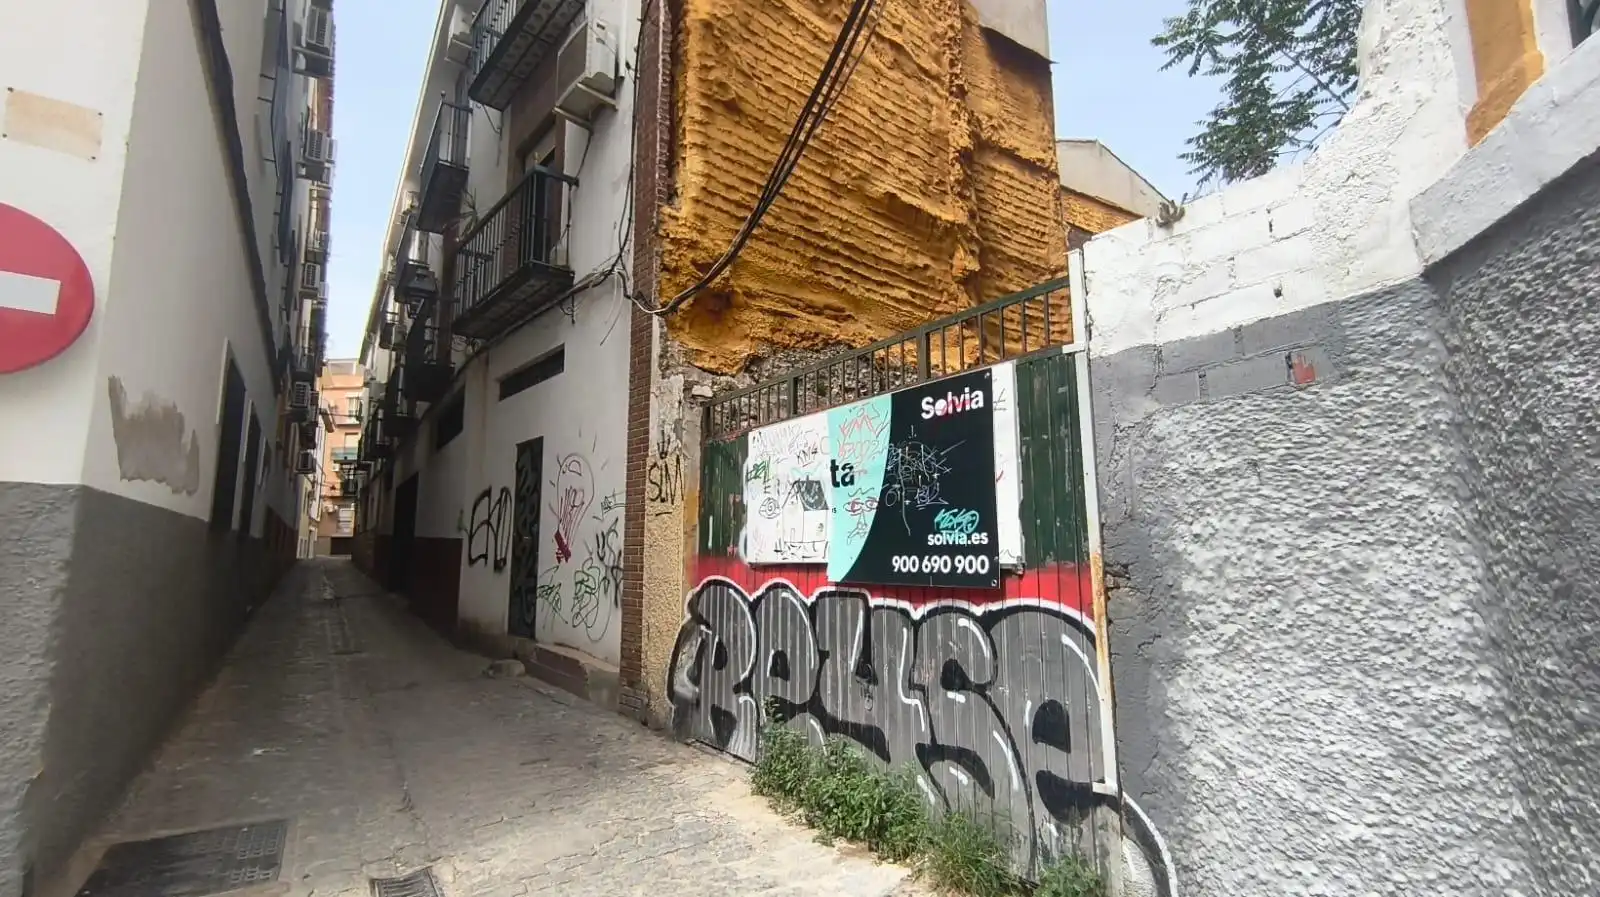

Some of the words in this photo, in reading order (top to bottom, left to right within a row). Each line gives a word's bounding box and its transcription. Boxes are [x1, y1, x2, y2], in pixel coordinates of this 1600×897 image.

[921, 386, 985, 420] Solvia
[830, 459, 855, 488] ta
[927, 530, 989, 546] solvia.es
[892, 555, 920, 573] 900
[922, 555, 952, 574] 690
[954, 554, 990, 575] 900
